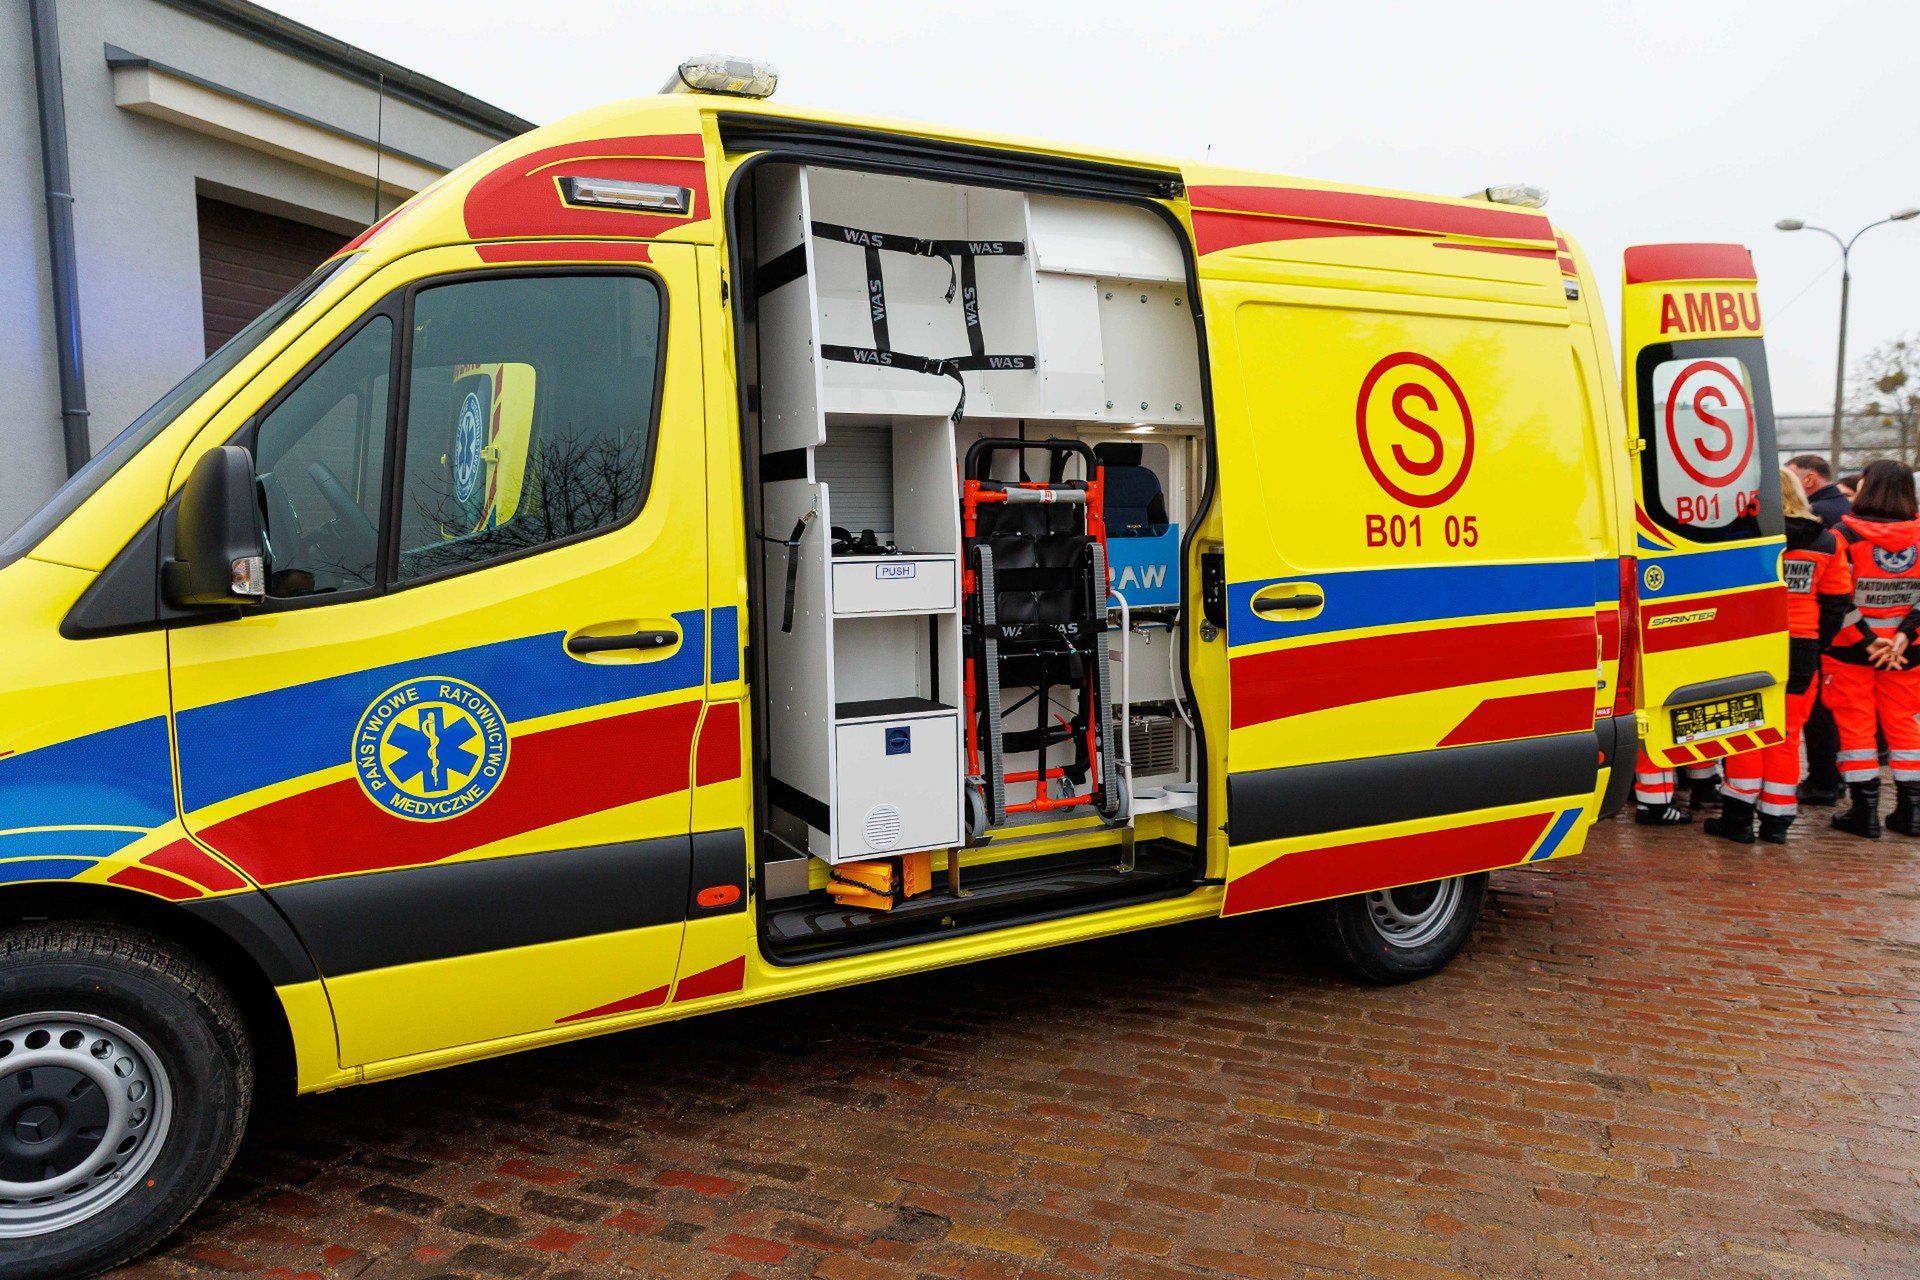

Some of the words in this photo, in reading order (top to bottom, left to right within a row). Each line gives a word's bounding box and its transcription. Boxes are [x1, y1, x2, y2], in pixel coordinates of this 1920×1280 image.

[844, 229, 883, 247] WAS
[968, 242, 1004, 254] WAS
[869, 279, 884, 322] WAS
[964, 287, 978, 326] WAS
[1660, 292, 1761, 334] AMBU
[853, 350, 892, 366] WAS
[989, 357, 1024, 368] WAS
[1391, 382, 1444, 476] S
[1693, 385, 1734, 462] S
[1676, 493, 1720, 525] B01
[1735, 490, 1761, 519] 05
[1365, 514, 1422, 548] B01
[1444, 514, 1479, 548] 05
[882, 566, 910, 576] PUSH
[1651, 611, 1715, 627] SPRINTER
[358, 687, 419, 791] PAŃSTWOWE
[439, 685, 503, 777] RATOWNICTWO
[389, 783, 485, 815] MEDYCZNE
